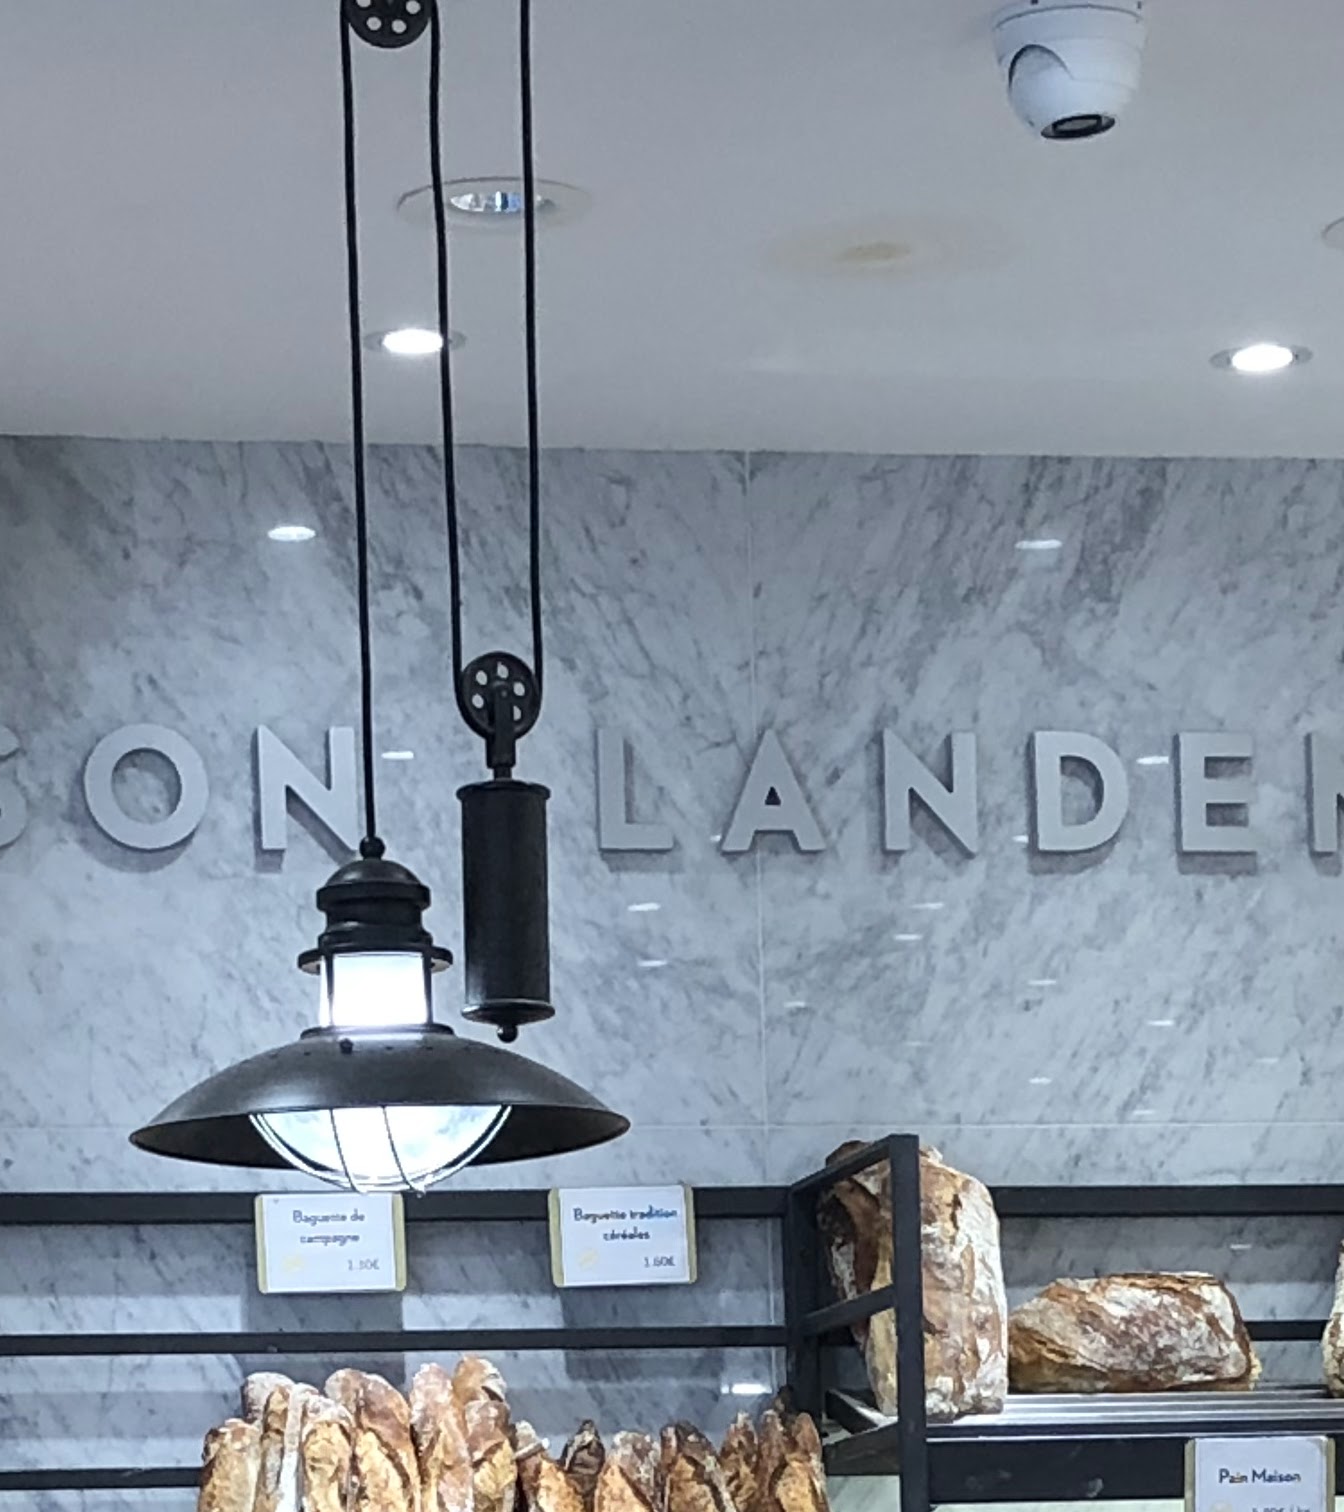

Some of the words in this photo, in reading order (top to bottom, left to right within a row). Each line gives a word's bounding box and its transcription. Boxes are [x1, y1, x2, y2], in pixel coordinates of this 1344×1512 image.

[350, 1208, 366, 1222] de
[573, 1207, 627, 1224] Baguette
[629, 1204, 678, 1220] tradition
[603, 1226, 651, 1241] céréales
[1218, 1468, 1248, 1484] Pain
[1251, 1468, 1302, 1484] Maison
